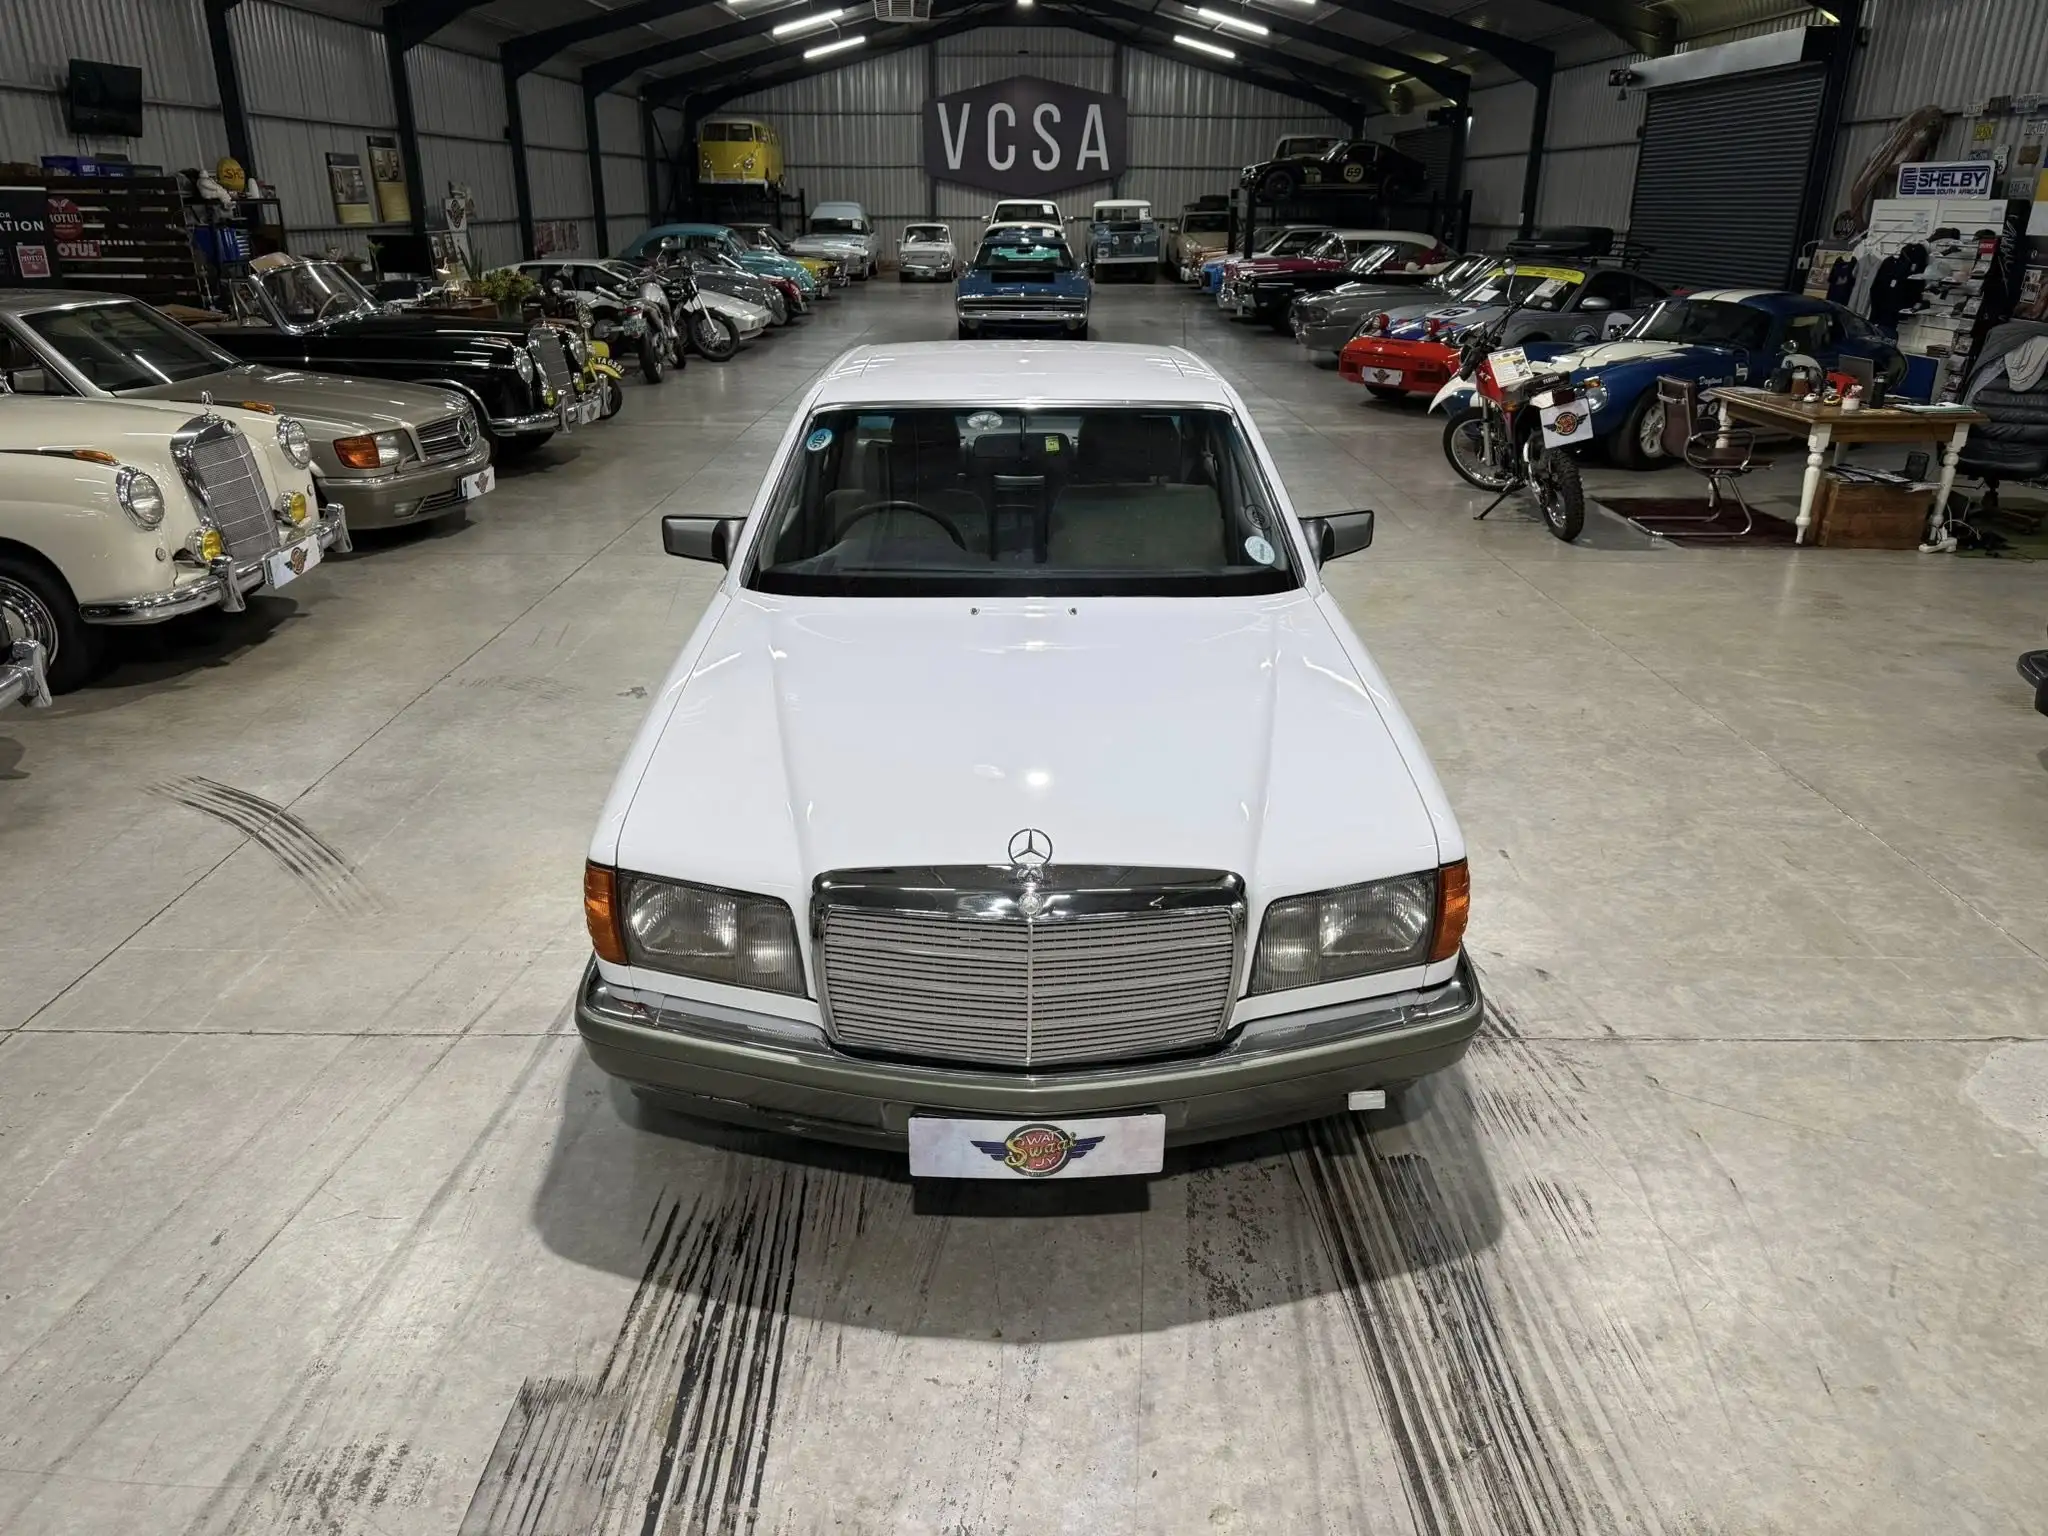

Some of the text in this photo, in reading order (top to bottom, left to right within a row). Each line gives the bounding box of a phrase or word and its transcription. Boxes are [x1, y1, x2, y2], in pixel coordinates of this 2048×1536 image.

[937, 102, 1110, 171] VCSA
[1346, 168, 1361, 177] 69
[1917, 172, 1986, 187] SHELBY
[57, 242, 98, 257] OTUL
[1479, 370, 1491, 381] XT
[1035, 1156, 1056, 1167] JY
